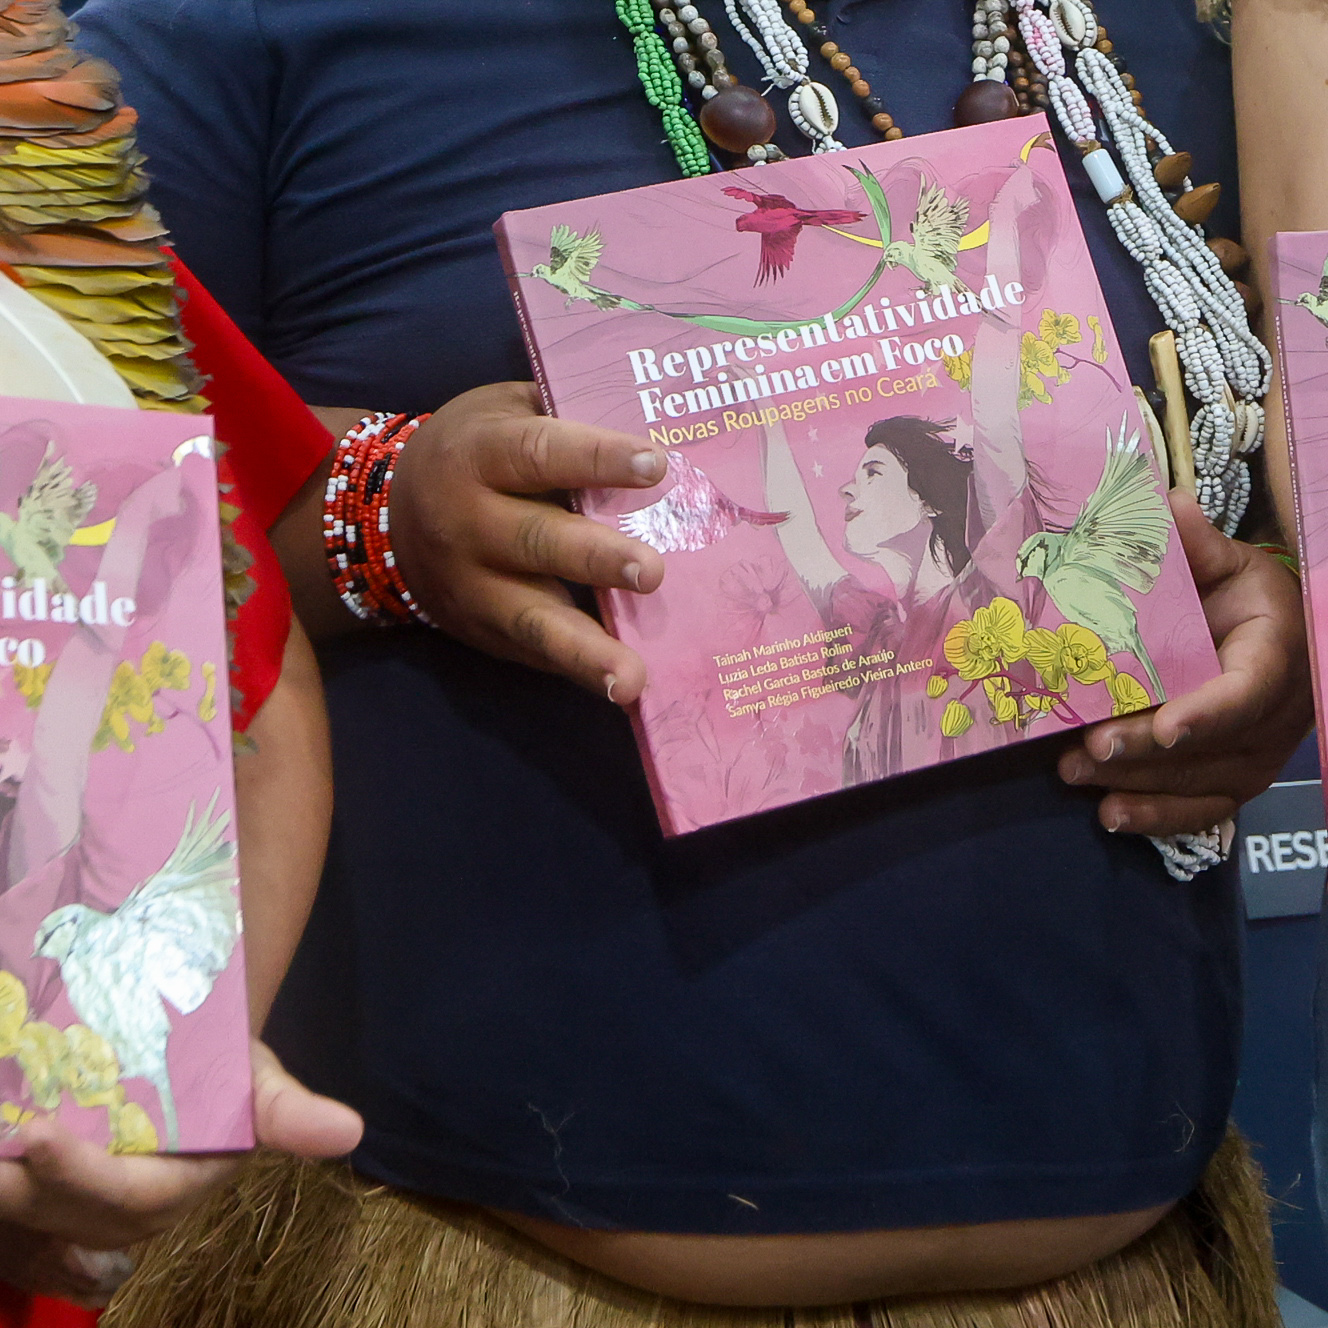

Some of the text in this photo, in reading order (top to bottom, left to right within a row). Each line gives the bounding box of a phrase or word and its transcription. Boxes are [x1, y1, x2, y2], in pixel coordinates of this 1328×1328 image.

[625, 274, 1026, 385] Representatividade
[637, 332, 965, 424] Feminina em Foco
[648, 370, 939, 448] Novas Roupagens no Ceará
[713, 623, 854, 668] Tainah Marinho Aldigueri
[718, 642, 853, 685] Luzia Leda Batista Rolim
[723, 649, 895, 701] Rachel Garcia Bastos de Araújo
[727, 699, 766, 718] Samya
[800, 676, 861, 699] Figueiredo
[861, 666, 895, 684] Vieira
[896, 658, 933, 675] Antero
